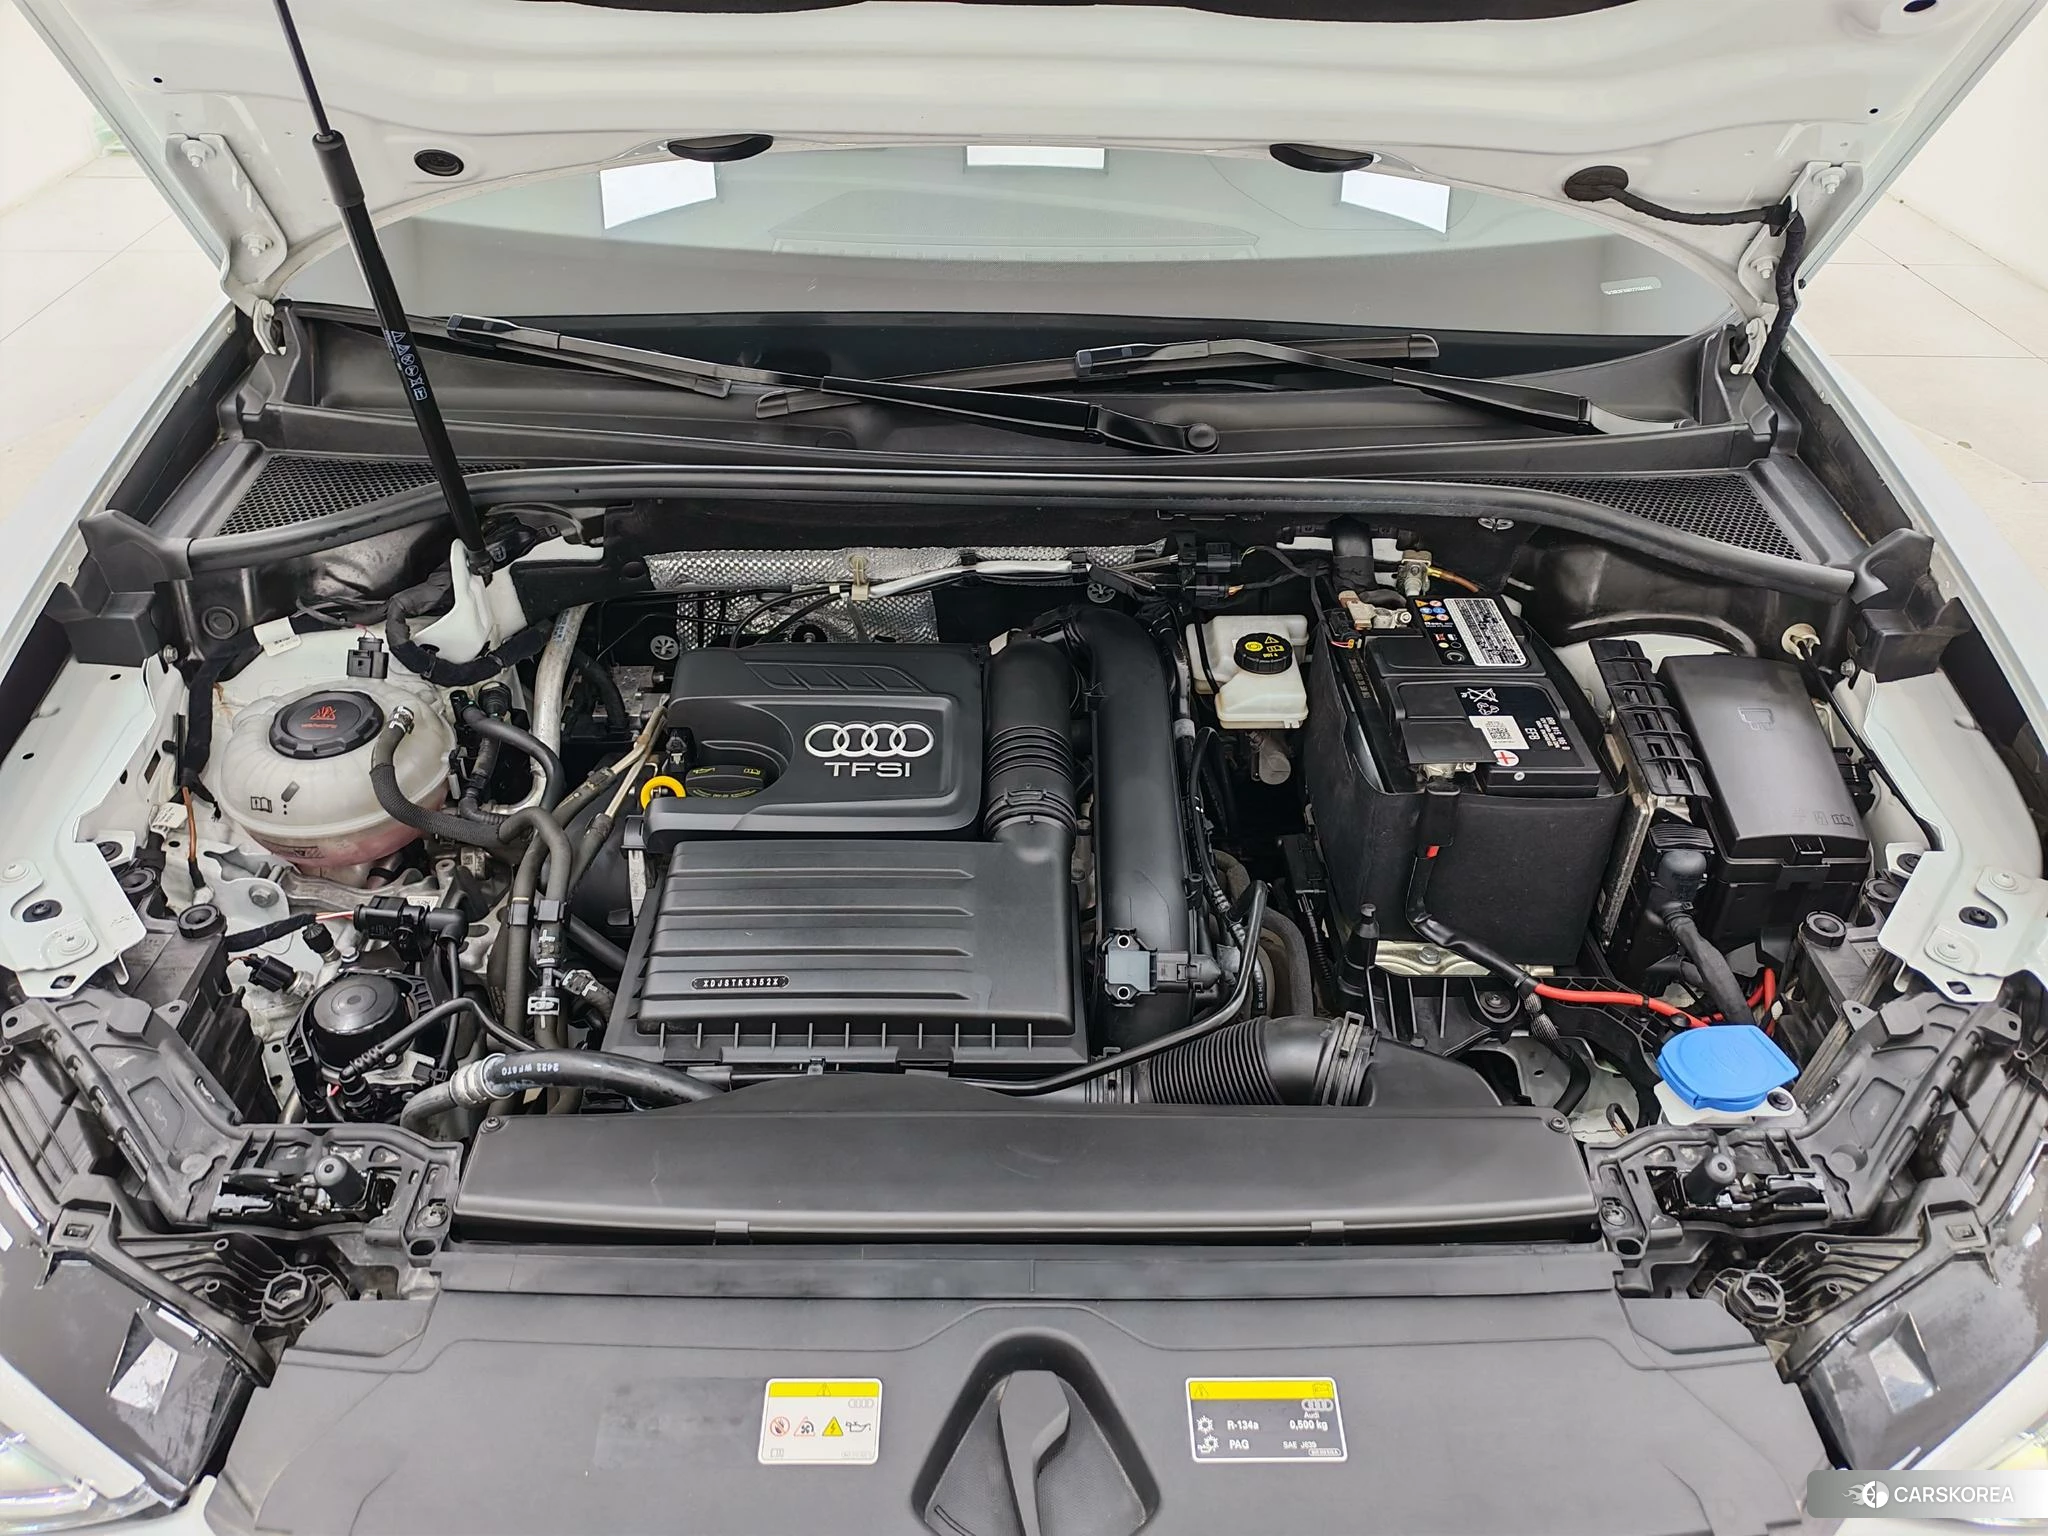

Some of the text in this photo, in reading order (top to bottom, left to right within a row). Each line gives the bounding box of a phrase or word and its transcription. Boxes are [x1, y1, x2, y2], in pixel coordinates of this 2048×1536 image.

[1524, 728, 1540, 739] EFB
[823, 761, 911, 778] TFSI
[1303, 1411, 1320, 1419] Audi
[1226, 1419, 1260, 1431] R-134a
[1316, 1419, 1329, 1431] kg
[1229, 1439, 1250, 1450] PAG
[1282, 1440, 1298, 1449] SAE
